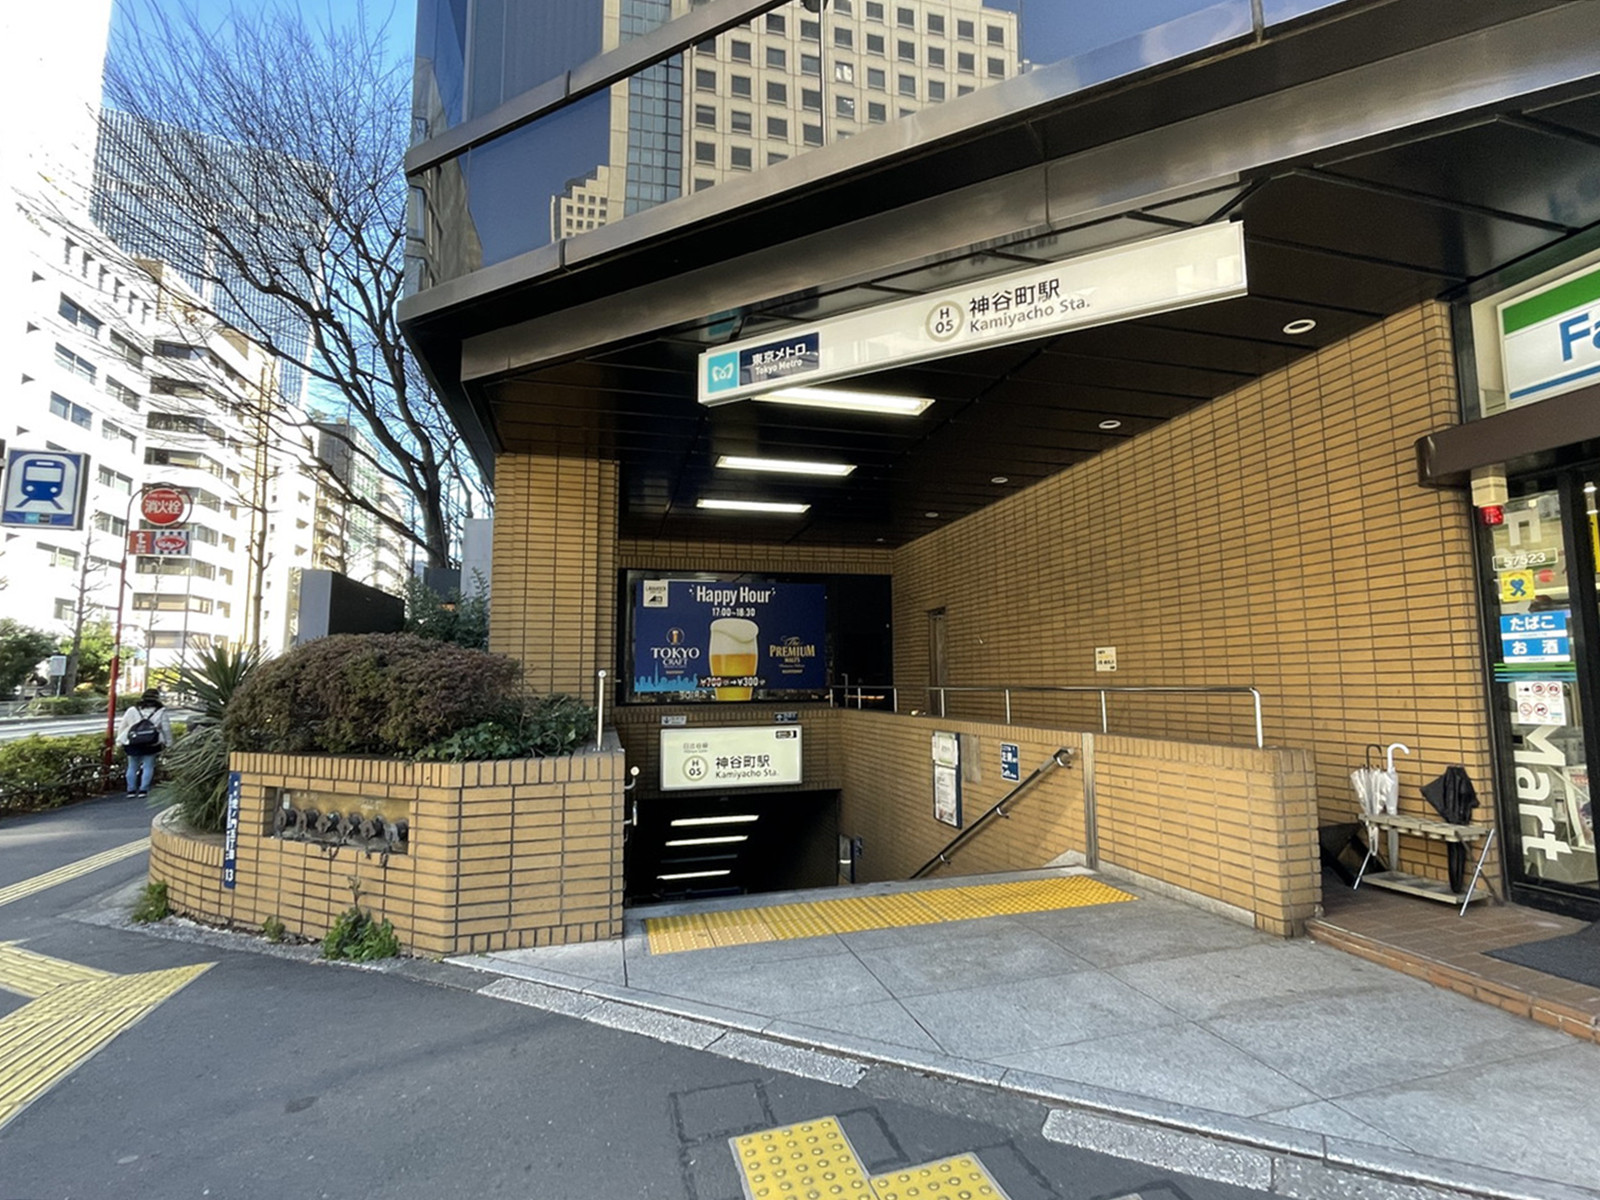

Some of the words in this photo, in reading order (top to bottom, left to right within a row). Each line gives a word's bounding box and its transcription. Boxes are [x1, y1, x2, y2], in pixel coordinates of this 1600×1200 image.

[969, 278, 1060, 318] 神谷町駅
[939, 307, 950, 320] H
[970, 304, 1054, 333] Kamiyacho
[1060, 297, 1091, 314] Sta.
[935, 320, 954, 334] 05
[755, 364, 778, 376] Tokyo
[779, 359, 803, 371] Metro
[144, 499, 181, 514] 消火栓
[696, 585, 738, 606] Happy
[739, 586, 771, 603] Hour
[1509, 615, 1556, 632] たばこ
[650, 647, 700, 659] TOKYO
[769, 645, 815, 657] PREMIUM
[662, 658, 688, 666] CRAFT
[716, 754, 770, 769] 神谷町駅
[689, 767, 702, 776] 05
[716, 769, 761, 780] Kamiyacho
[763, 768, 778, 776] Sta.
[1512, 714, 1573, 862] Mart
[225, 868, 233, 881] 13
